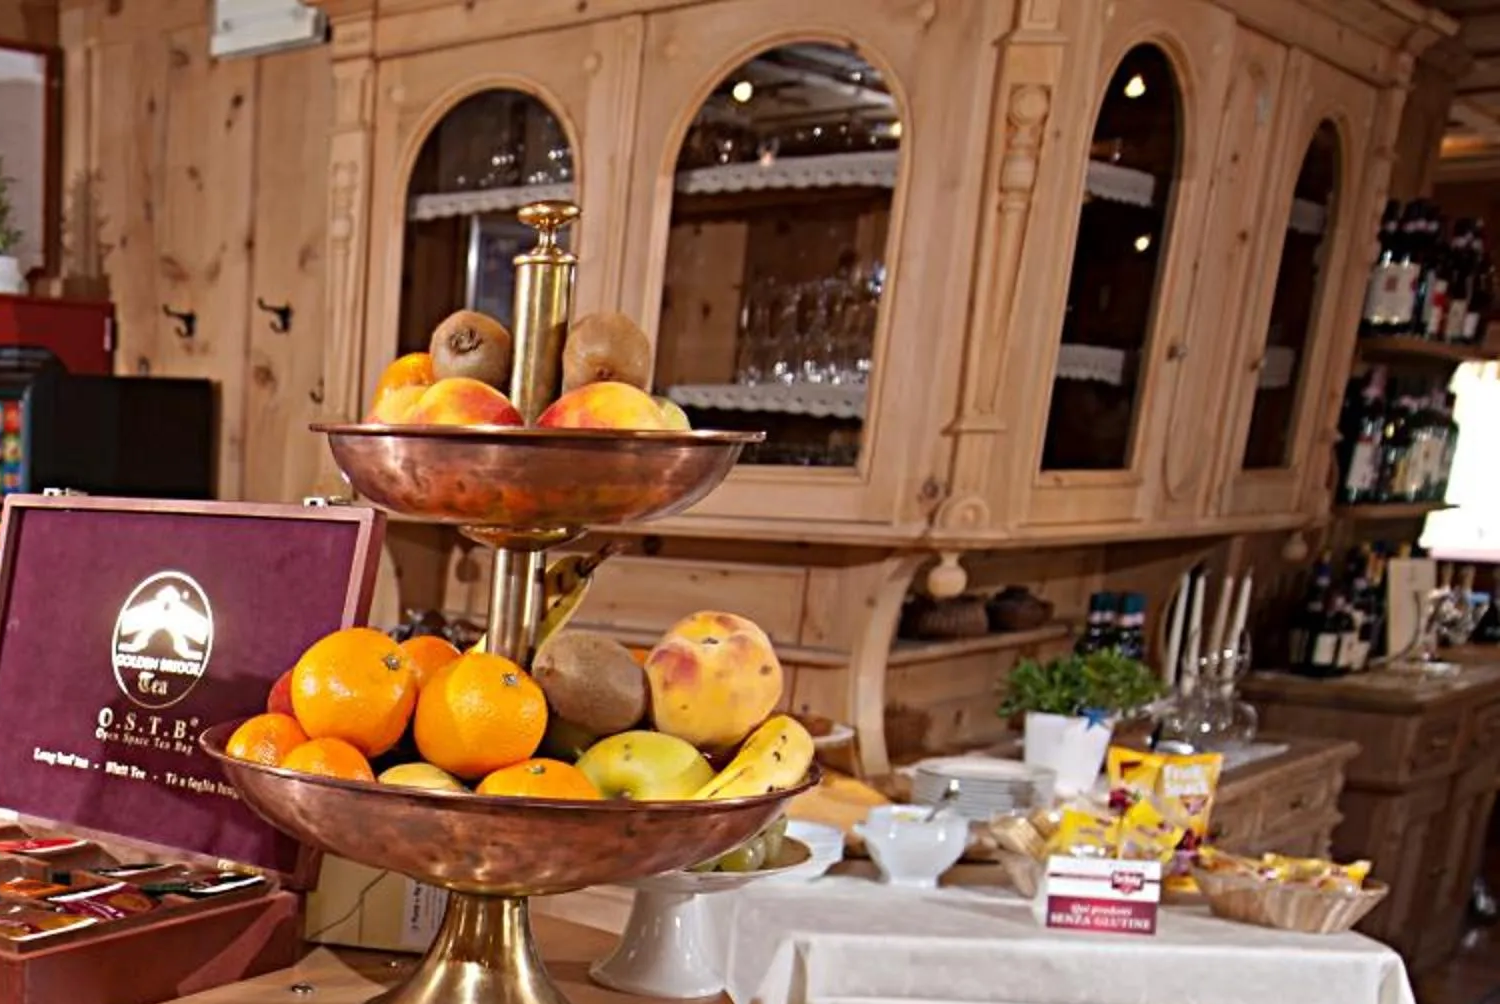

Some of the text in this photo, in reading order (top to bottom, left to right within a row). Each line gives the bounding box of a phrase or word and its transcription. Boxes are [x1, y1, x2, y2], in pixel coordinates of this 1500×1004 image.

[137, 671, 169, 695] Tea
[1050, 912, 1152, 931] SENZA GLUTINE
